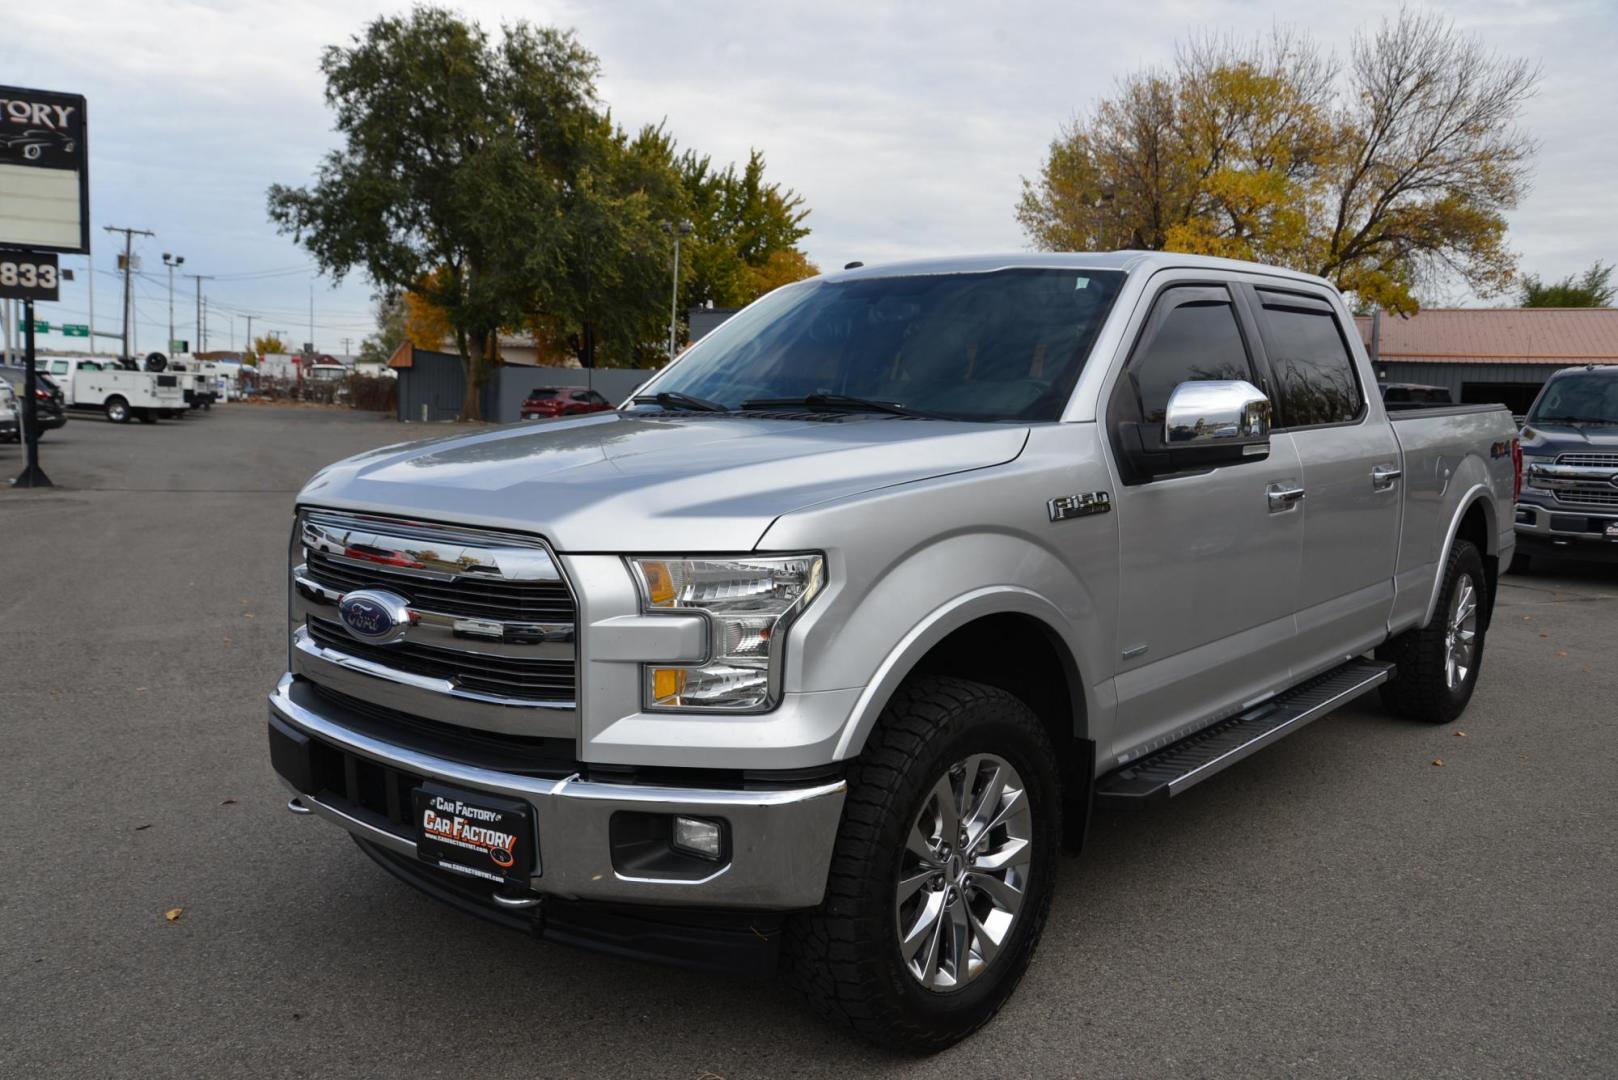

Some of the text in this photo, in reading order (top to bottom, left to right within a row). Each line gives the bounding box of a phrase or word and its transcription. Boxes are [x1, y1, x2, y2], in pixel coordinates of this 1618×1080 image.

[0, 262, 57, 289] 833
[455, 800, 497, 822] FACTORY
[423, 809, 515, 850] CAR FACTORY
